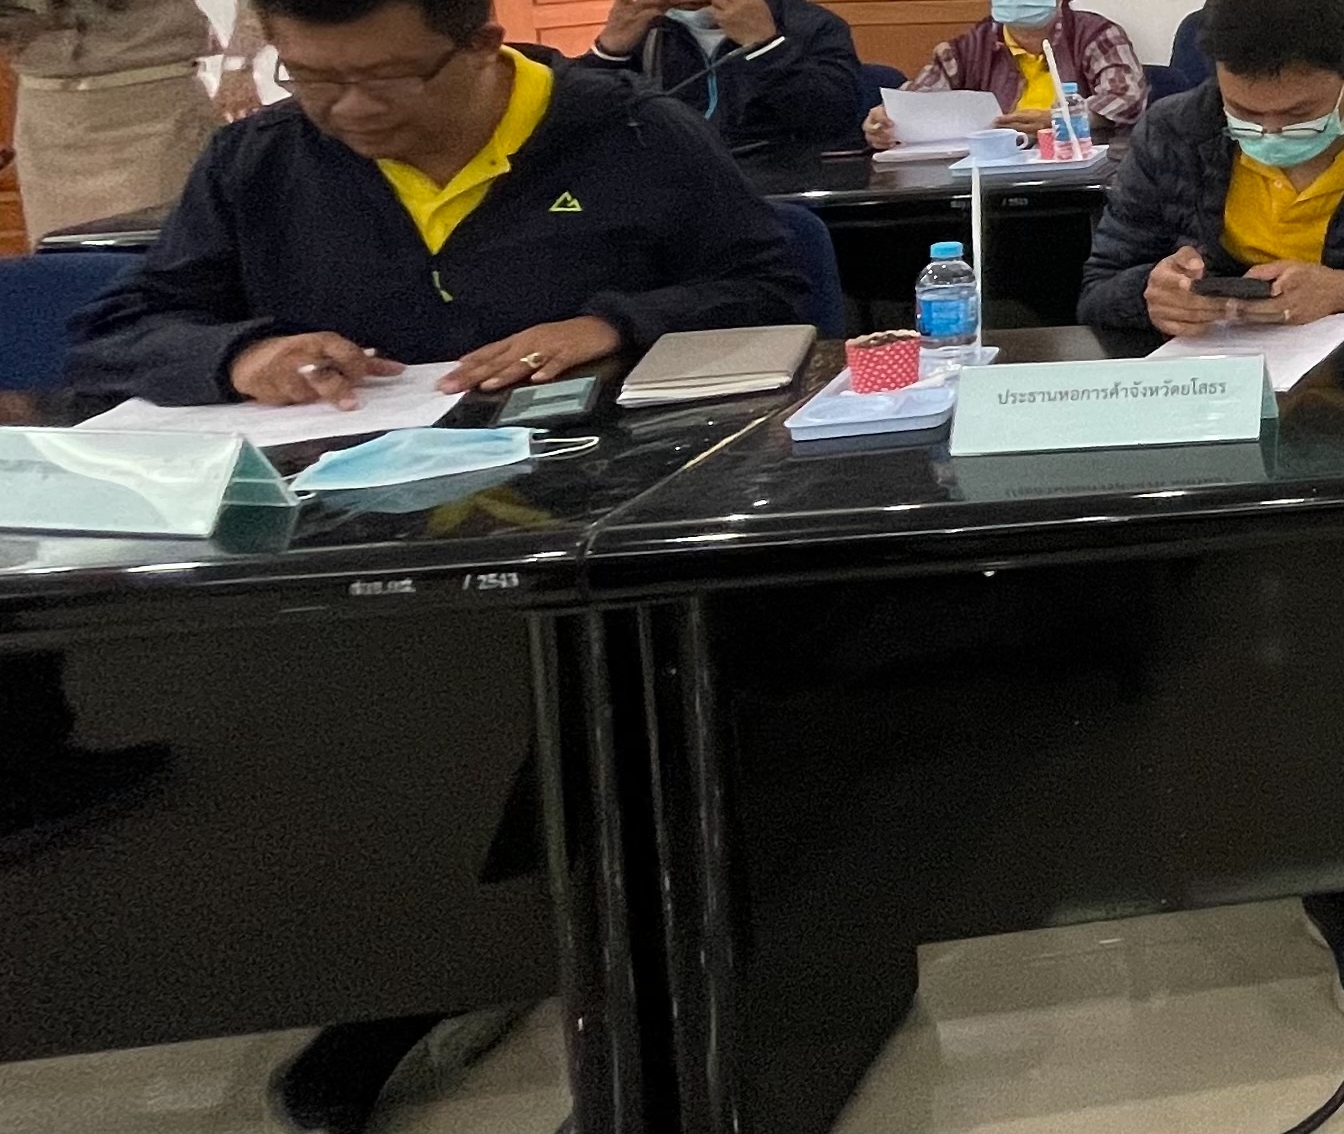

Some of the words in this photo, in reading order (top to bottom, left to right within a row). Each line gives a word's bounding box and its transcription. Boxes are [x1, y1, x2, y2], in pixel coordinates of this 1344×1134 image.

[997, 377, 1228, 405] ประธานหอการค้าจังหวัดยโสธร
